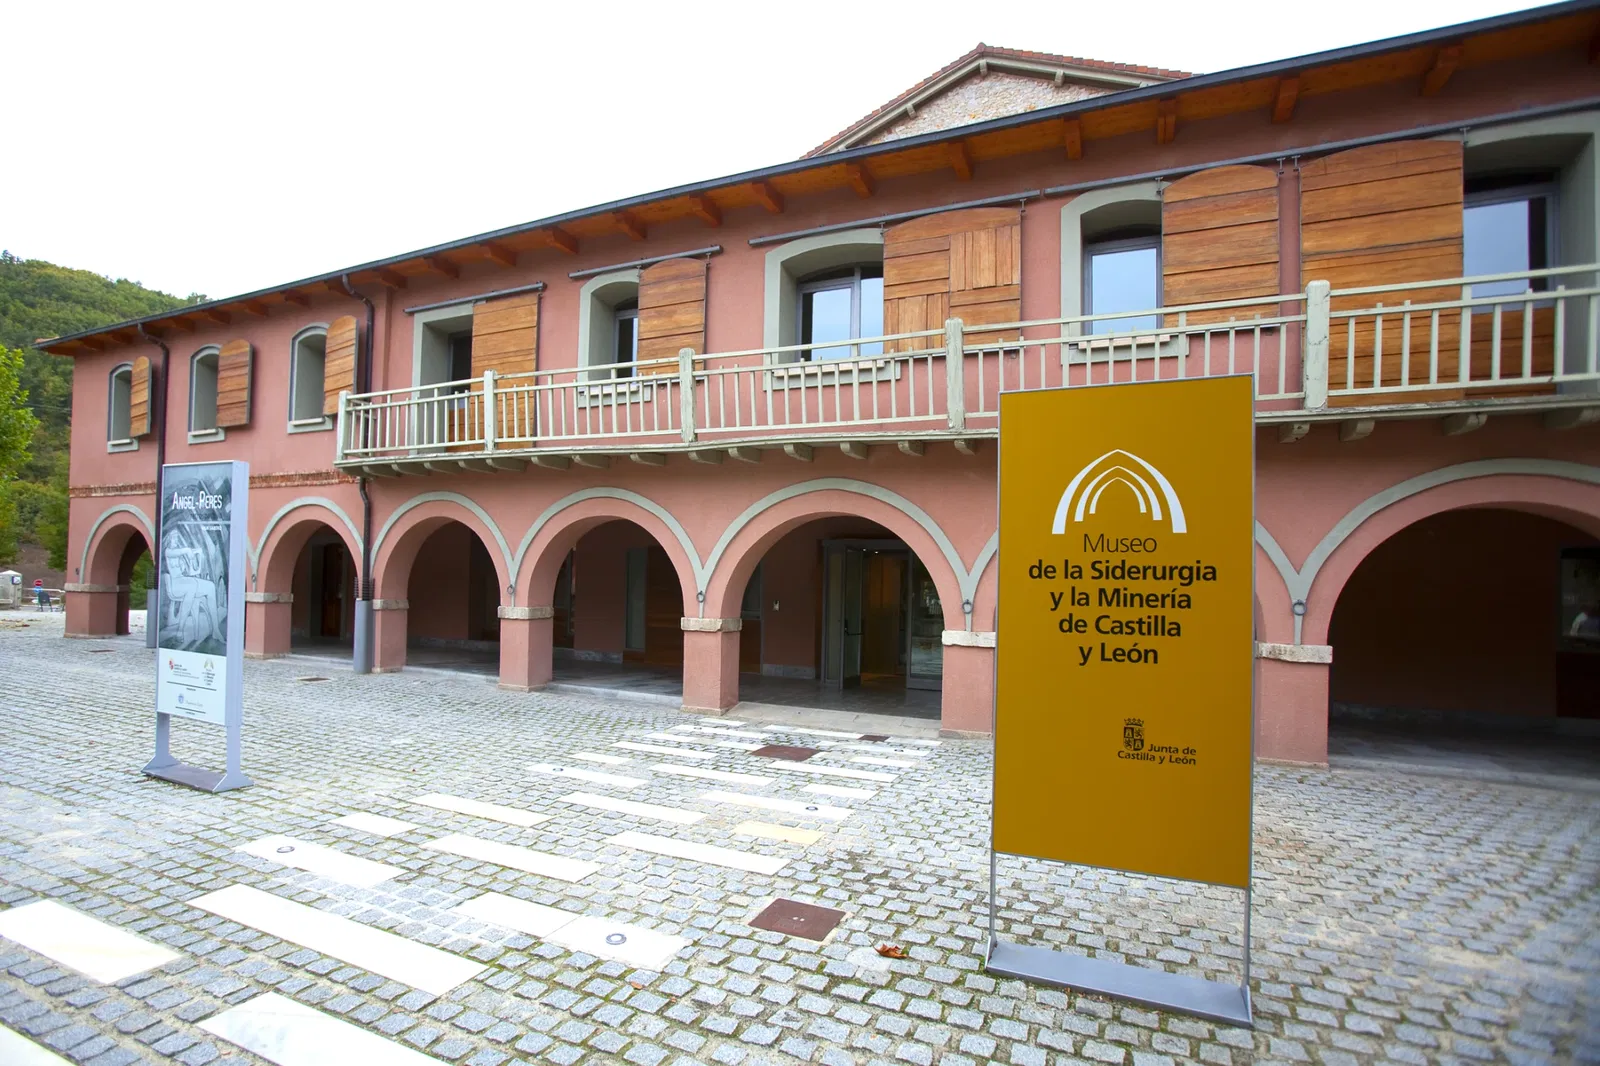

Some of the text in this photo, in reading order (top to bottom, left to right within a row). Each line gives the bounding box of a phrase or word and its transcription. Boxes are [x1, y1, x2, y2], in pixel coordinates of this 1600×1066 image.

[1083, 533, 1158, 553] Museo
[1028, 559, 1217, 587] de la Siderurgia
[1050, 586, 1192, 611] y la Minería
[1058, 613, 1181, 637] de Castilla
[1079, 643, 1158, 666] y León
[1117, 750, 1197, 766] Castilla y León
[1148, 743, 1197, 756] Junta de
